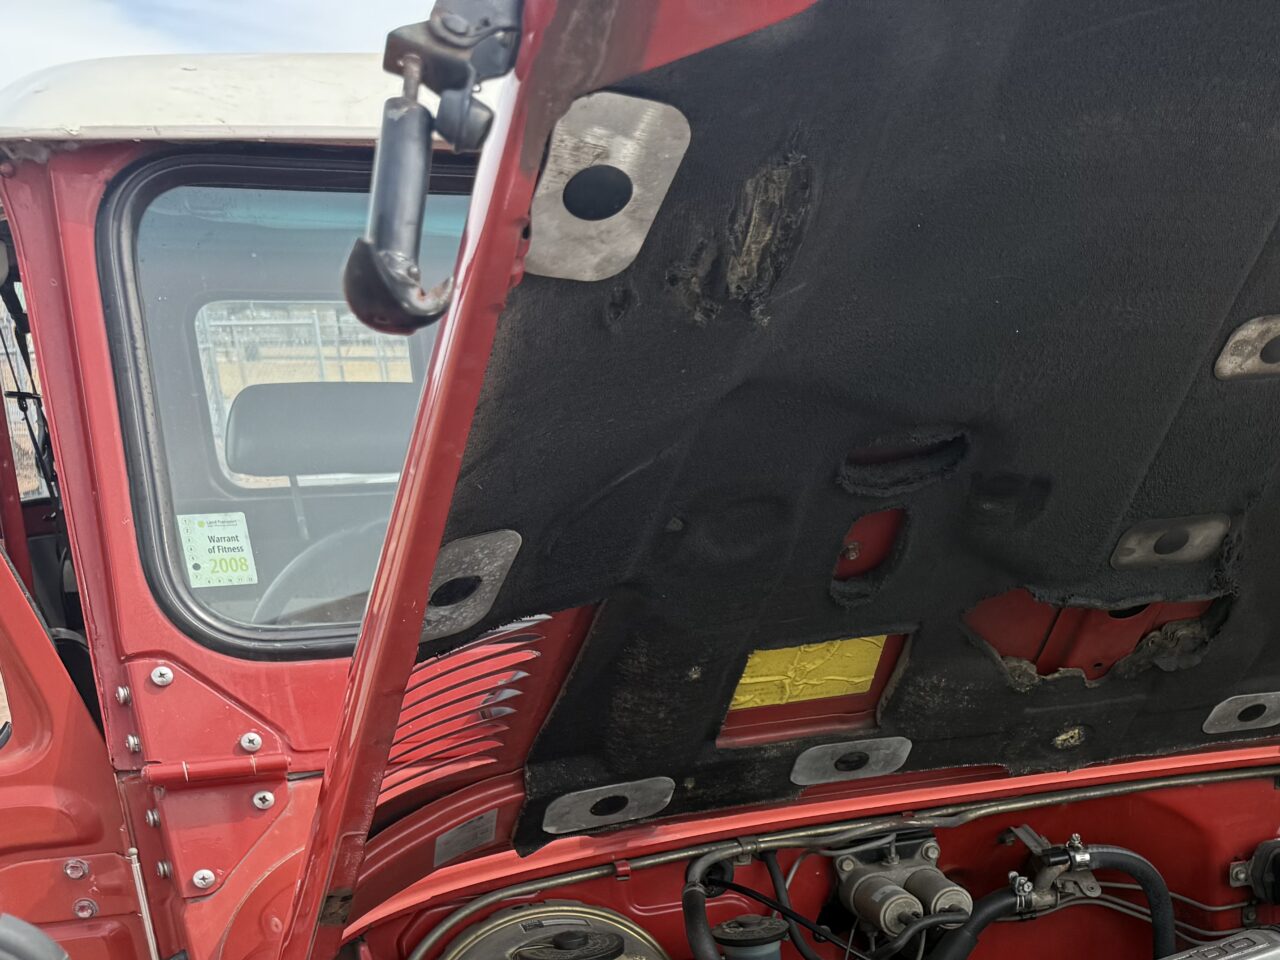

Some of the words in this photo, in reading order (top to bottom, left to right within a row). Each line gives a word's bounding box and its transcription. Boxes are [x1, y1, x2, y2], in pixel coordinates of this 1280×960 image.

[207, 534, 240, 544] Warrant
[207, 546, 216, 554] of
[217, 545, 245, 554] Fitness
[209, 556, 249, 574] 2008
